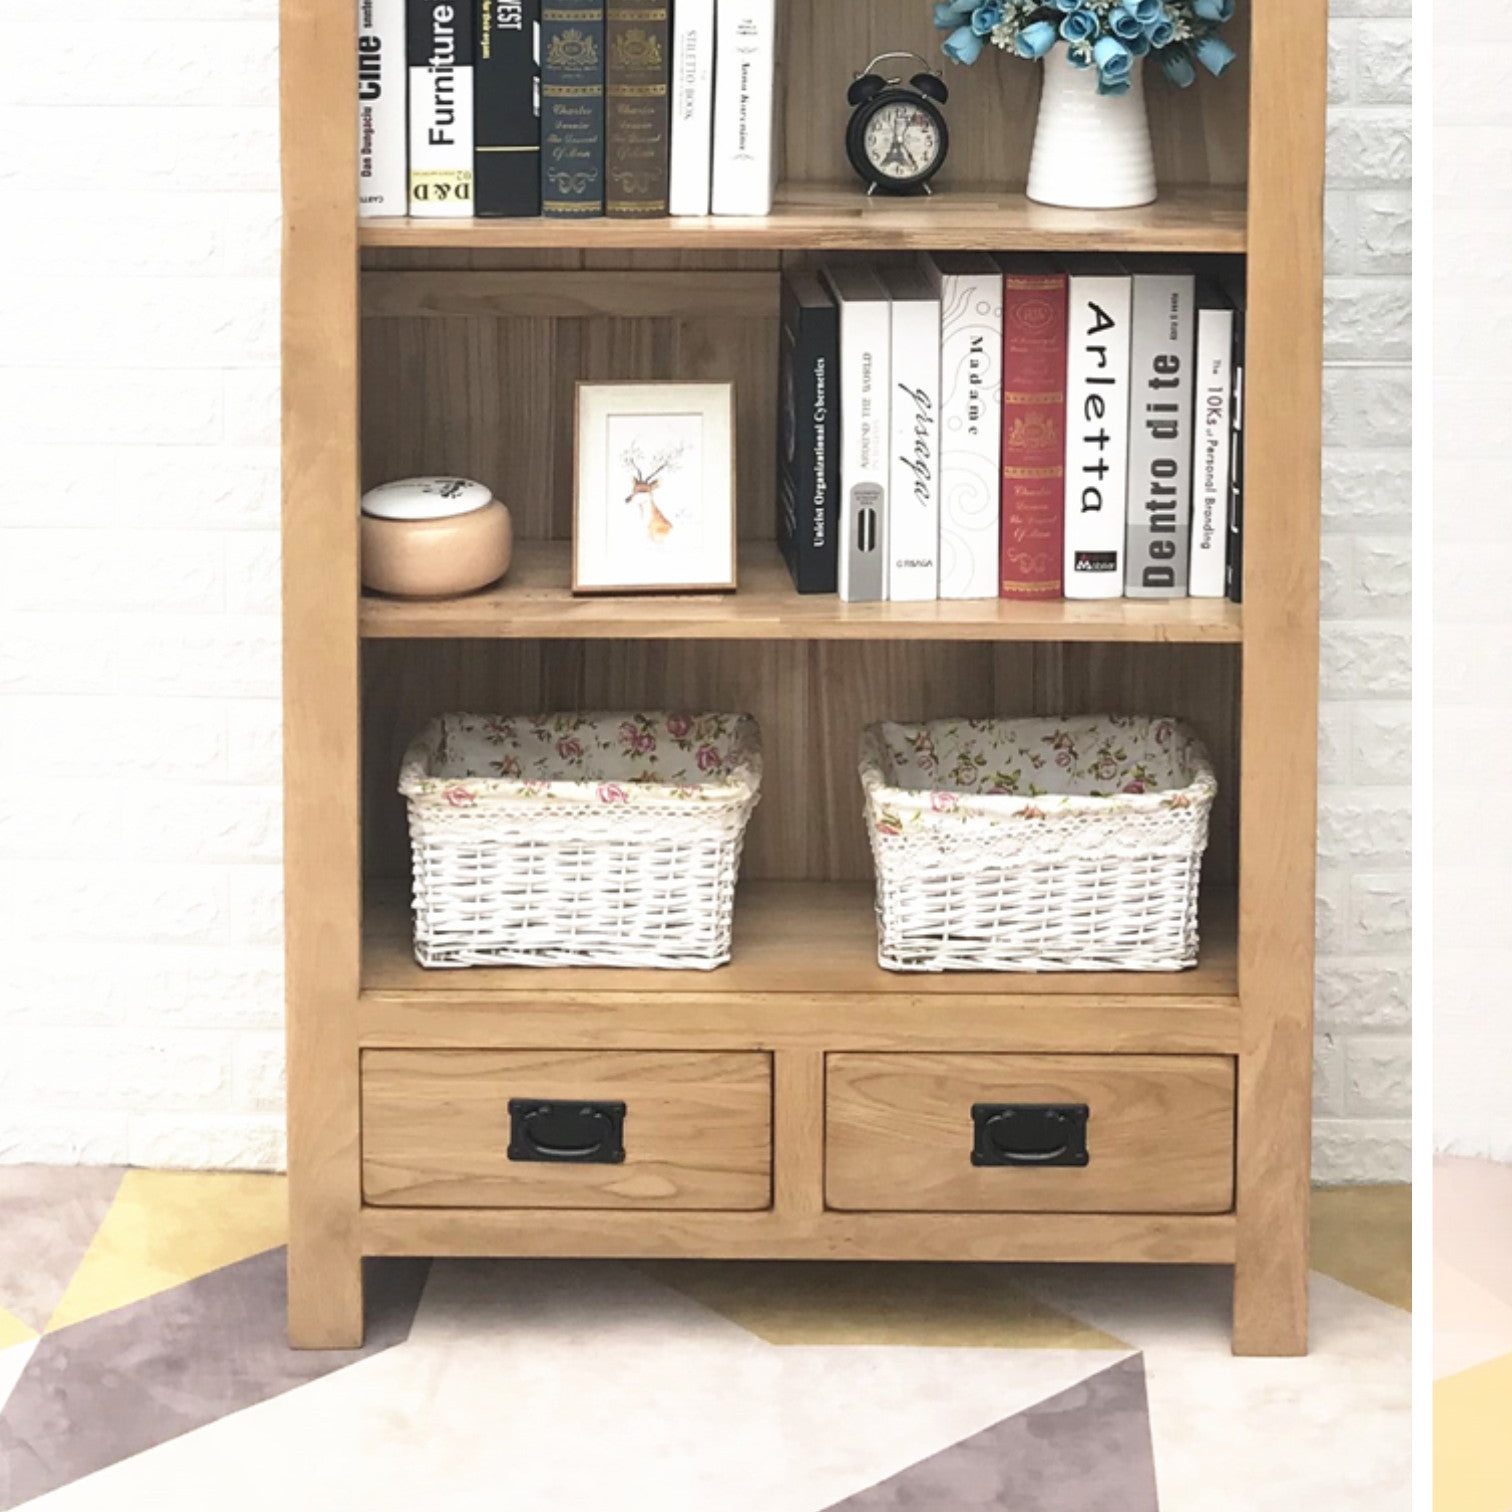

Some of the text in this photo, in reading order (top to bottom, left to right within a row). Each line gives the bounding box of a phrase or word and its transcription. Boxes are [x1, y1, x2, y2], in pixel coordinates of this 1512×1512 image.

[358, 35, 382, 101] Cine
[428, 3, 456, 146] Furniture
[361, 152, 373, 178] Dan
[968, 336, 984, 435] Madame
[1081, 301, 1116, 513] Arletta
[1207, 387, 1223, 426] 10Ks
[813, 357, 827, 547] Unicist Organizational Cybernetics
[1142, 354, 1180, 588] Dentro di te
[1205, 440, 1218, 494] Personal
[1200, 497, 1216, 550] Branding
